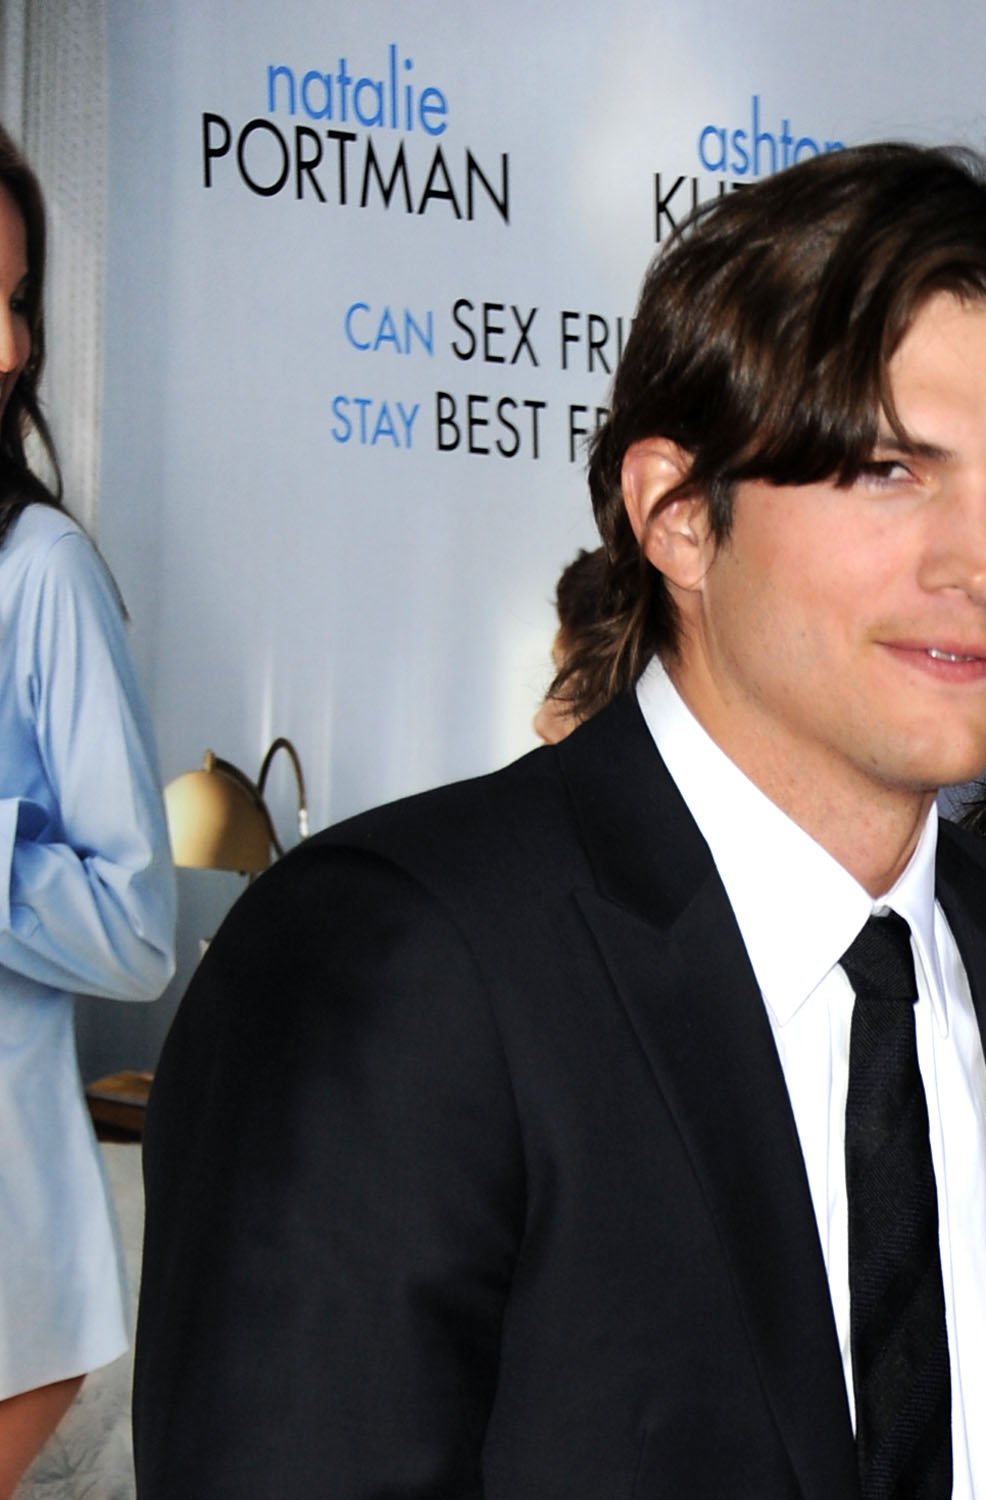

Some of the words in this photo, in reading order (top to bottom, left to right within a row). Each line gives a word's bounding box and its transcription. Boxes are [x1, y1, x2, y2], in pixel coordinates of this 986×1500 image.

[266, 44, 449, 136] natalie
[202, 112, 511, 225] PORTMAN
[344, 303, 435, 358] CAN
[451, 299, 540, 367] SEX
[331, 396, 420, 449] STAY
[435, 392, 546, 460] BEST
